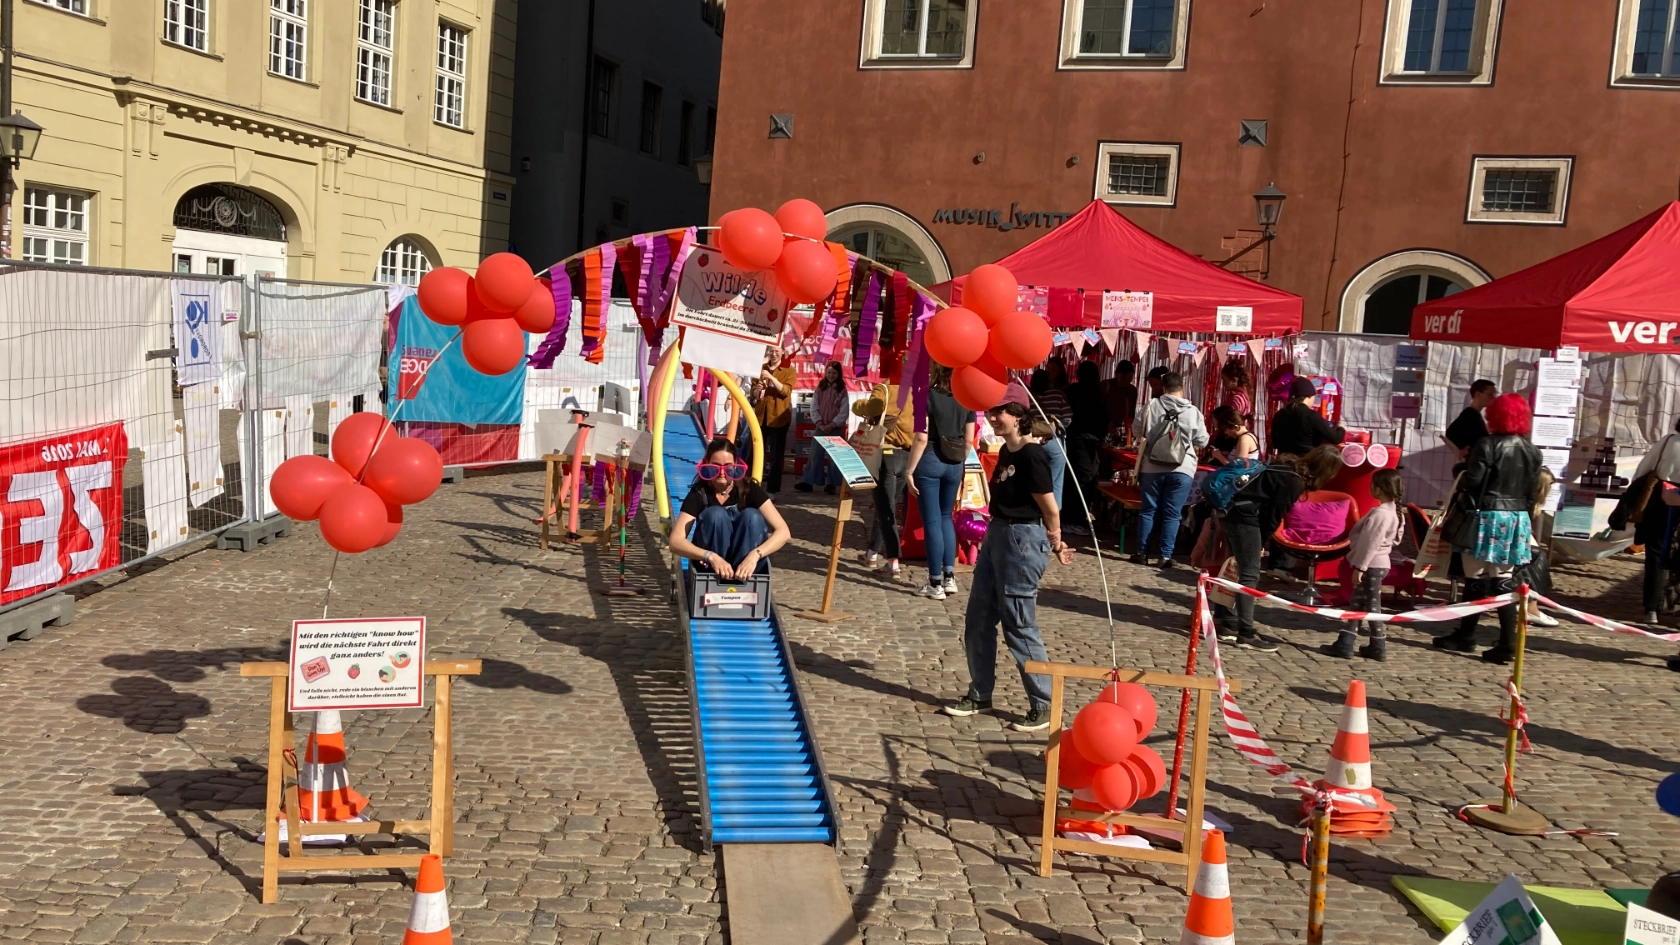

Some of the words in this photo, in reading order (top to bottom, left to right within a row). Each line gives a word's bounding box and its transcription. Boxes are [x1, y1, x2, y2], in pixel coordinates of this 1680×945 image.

[933, 208, 1002, 228] MUSIK
[701, 271, 767, 306] Wilde
[708, 295, 755, 314] Erdbeere
[330, 631, 368, 639] richtigen
[320, 641, 333, 649] die
[333, 641, 366, 649] nächste
[330, 652, 352, 660] ganz
[1634, 918, 1677, 936] STECKBRIEF
